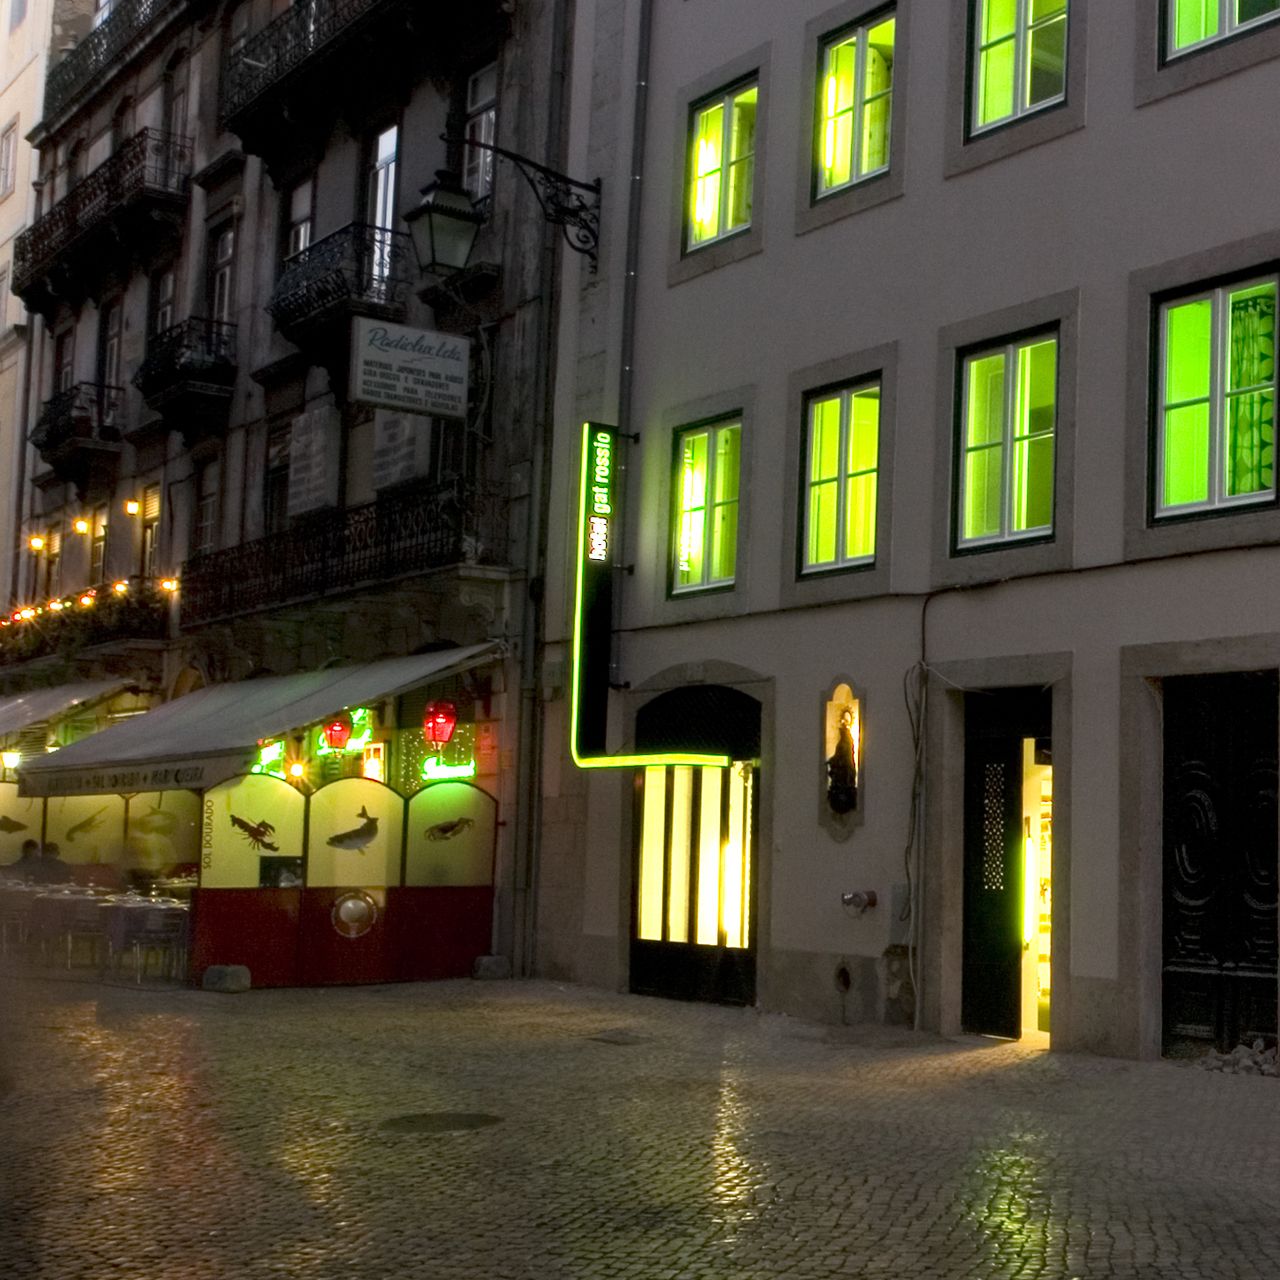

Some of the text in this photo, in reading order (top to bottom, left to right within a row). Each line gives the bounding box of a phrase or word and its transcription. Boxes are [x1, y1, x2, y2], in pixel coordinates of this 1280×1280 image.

[589, 432, 612, 561] hotel gat rossio
[203, 799, 214, 870] SOL DOURADO
